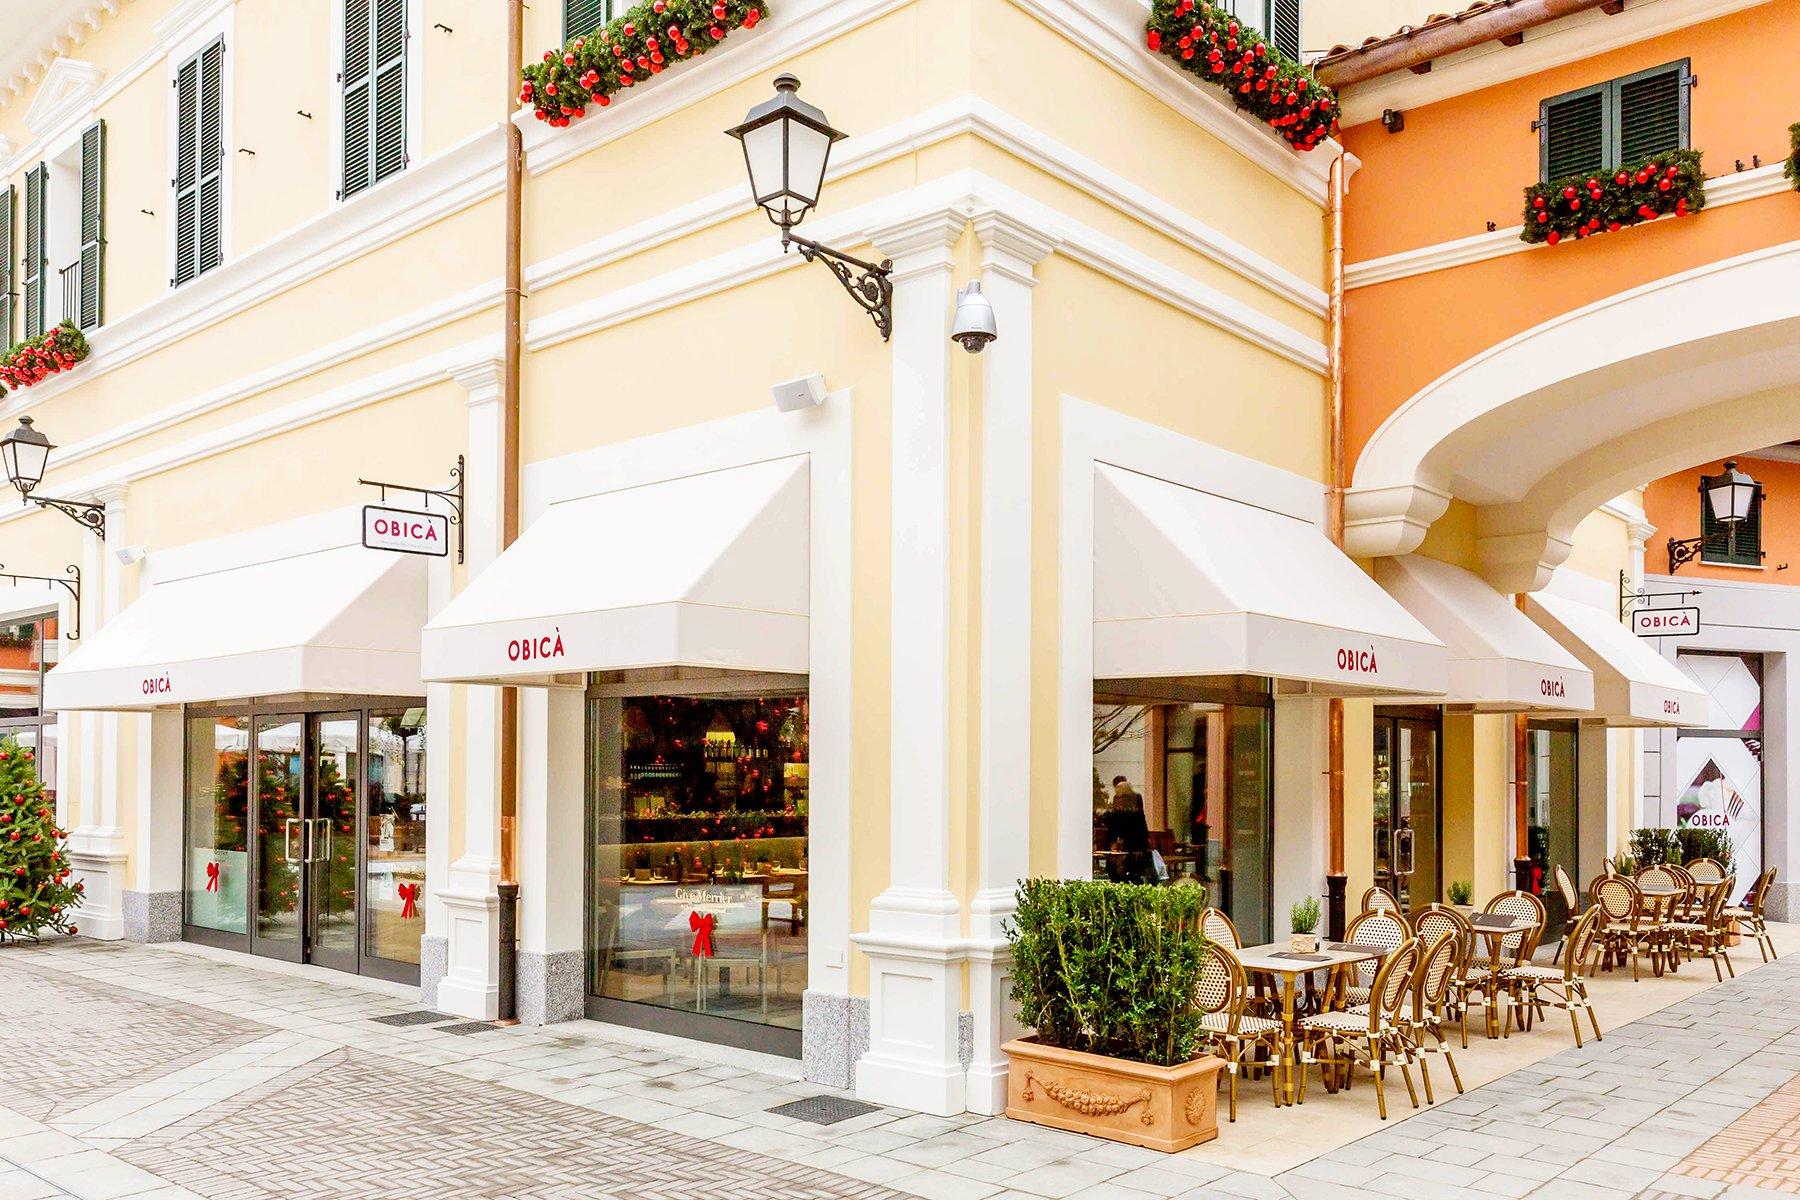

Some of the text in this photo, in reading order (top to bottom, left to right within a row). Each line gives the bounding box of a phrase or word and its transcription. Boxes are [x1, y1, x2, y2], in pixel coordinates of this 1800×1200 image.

[373, 517, 438, 542] OBICÀ
[1640, 611, 1691, 628] OBICÀ
[508, 627, 565, 661] OBICÀ
[1337, 644, 1378, 673] OBICÀ
[142, 671, 171, 695] OBICÀ
[1540, 676, 1566, 698] OBICÀ
[1663, 698, 1681, 715] OBICÀ
[1691, 810, 1730, 827] OBICÀ
